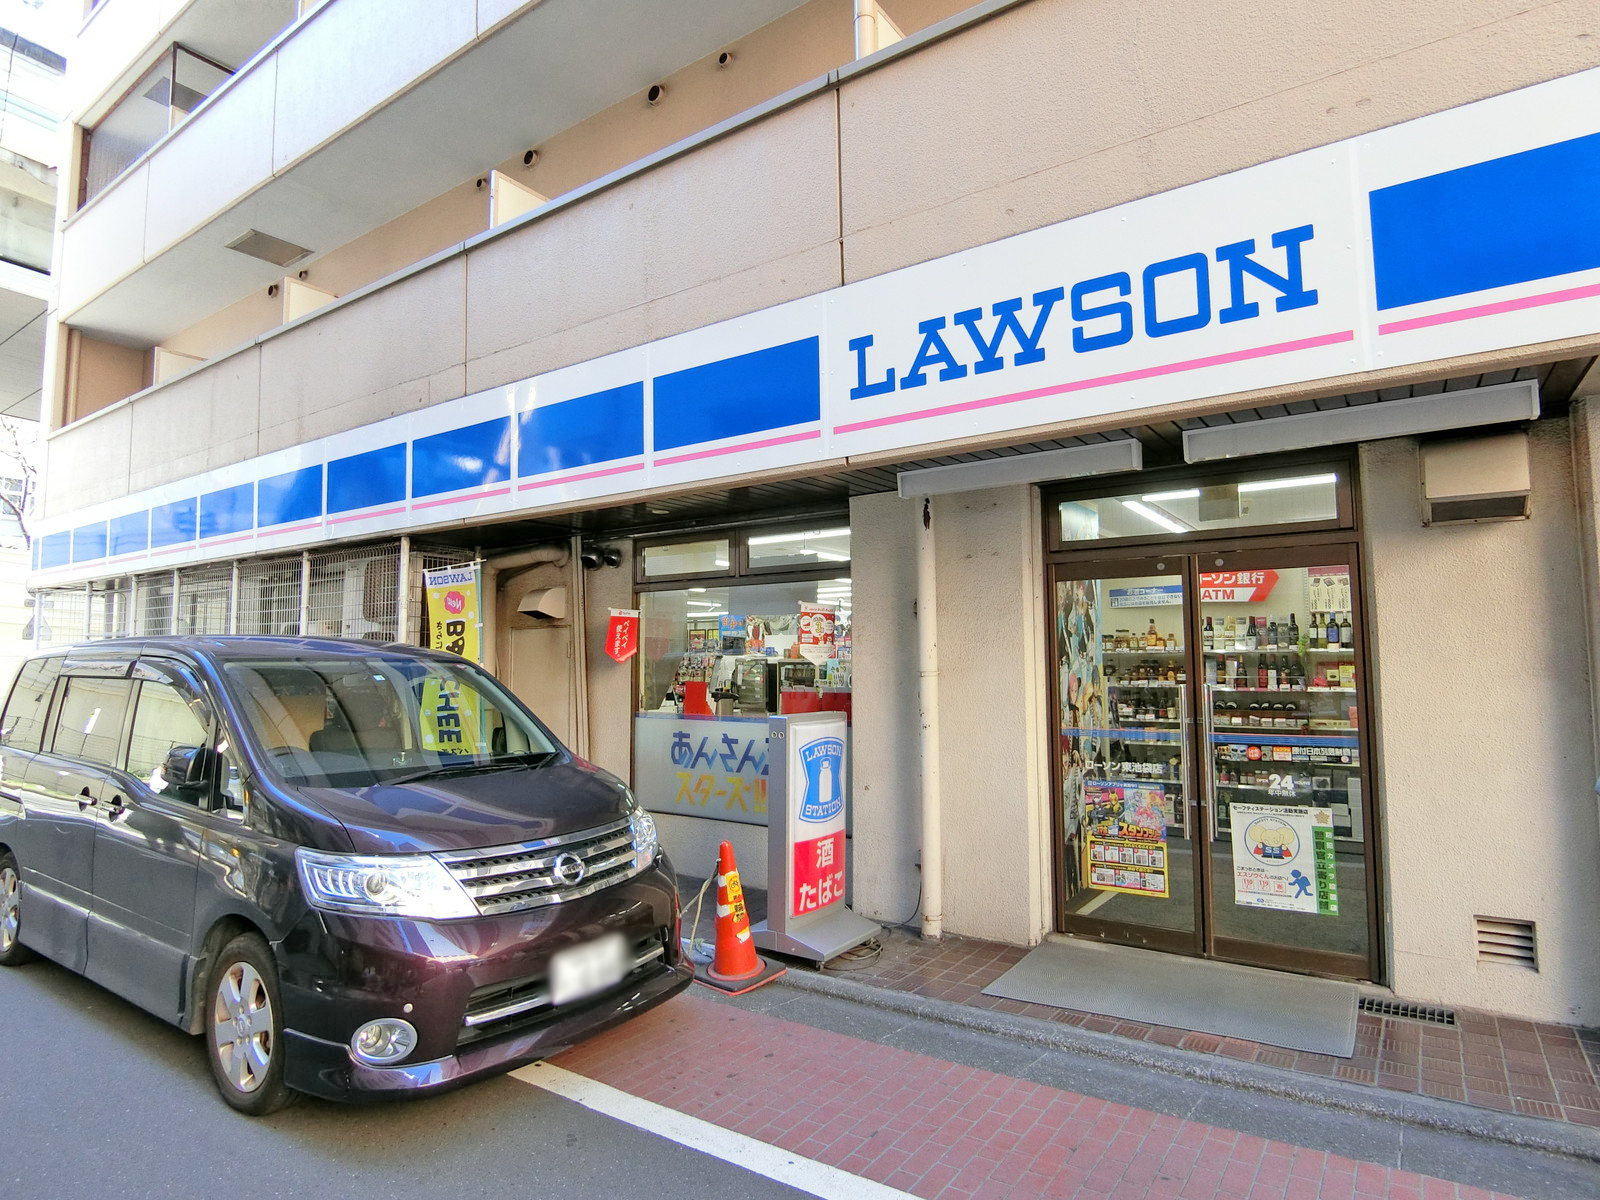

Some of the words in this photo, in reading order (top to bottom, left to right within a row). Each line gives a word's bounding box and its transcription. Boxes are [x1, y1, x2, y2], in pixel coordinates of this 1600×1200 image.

[849, 224, 1319, 400] LAWSON
[1201, 589, 1236, 601] ATM
[621, 619, 631, 650] ペイペイ
[670, 730, 769, 776] あんさん
[805, 744, 843, 763] LAWSON
[1085, 760, 1164, 775] ローソン東池袋店
[1268, 773, 1295, 790] 24
[1267, 788, 1297, 798] 年中無休
[804, 796, 843, 817] STATION
[816, 837, 834, 869] 酒
[799, 870, 844, 913] たばこ
